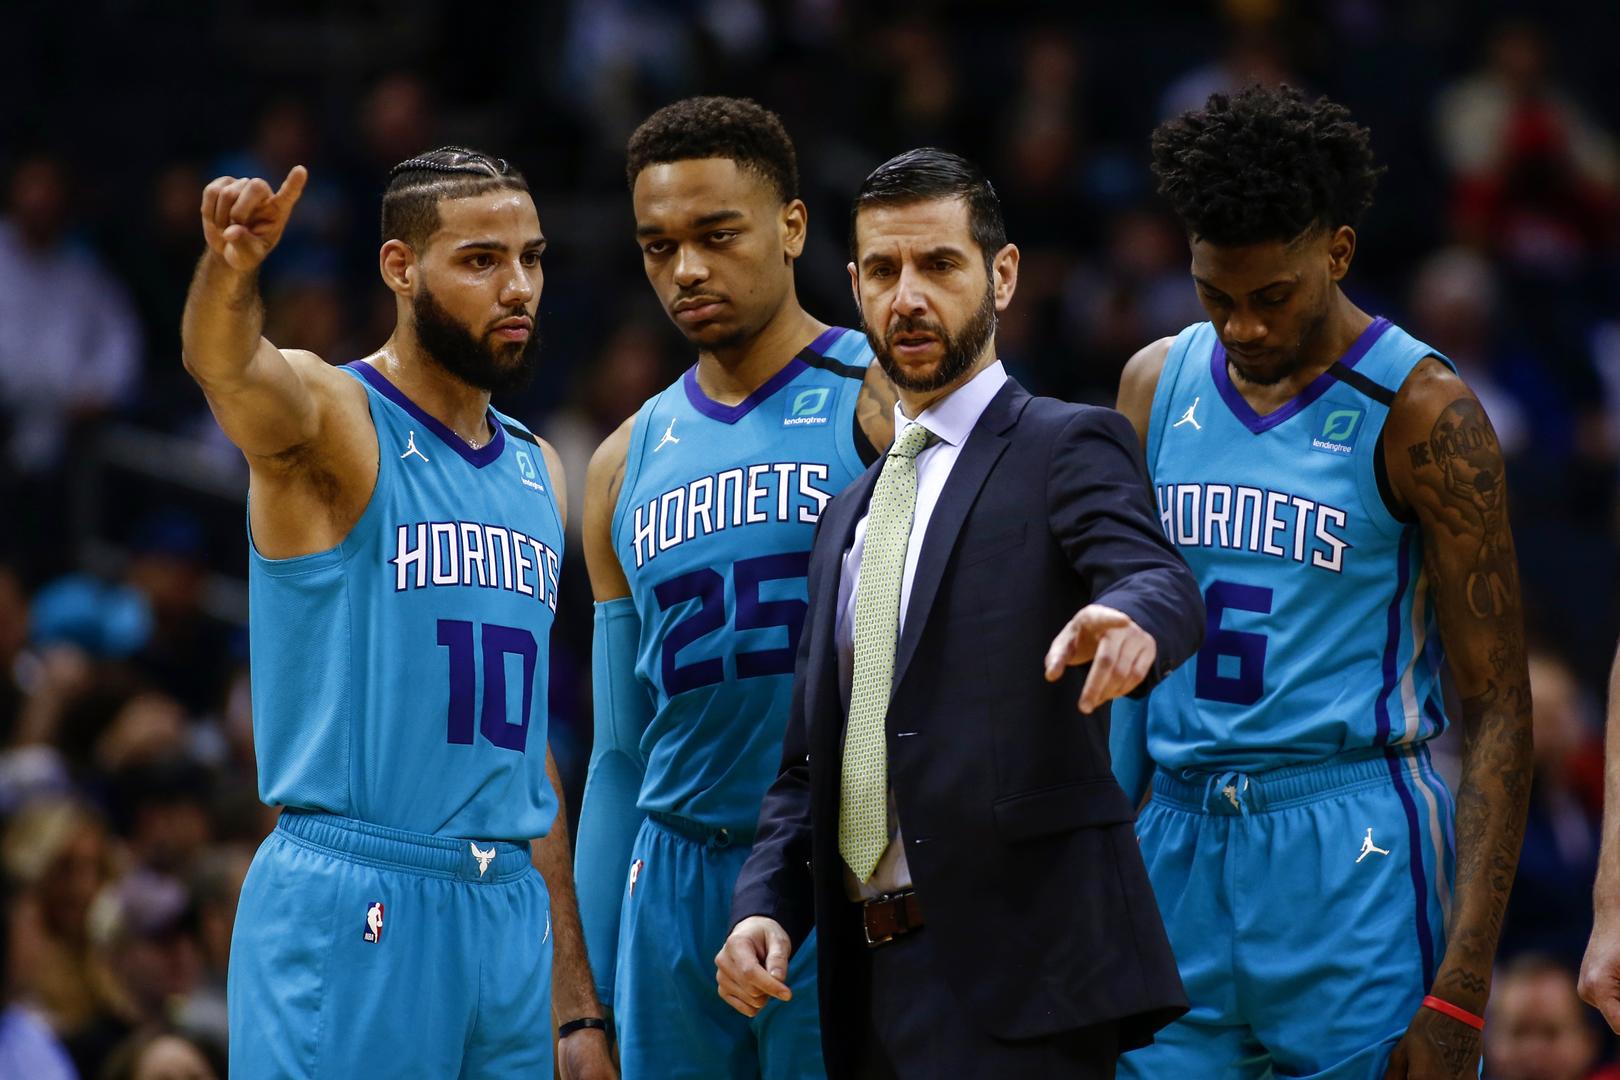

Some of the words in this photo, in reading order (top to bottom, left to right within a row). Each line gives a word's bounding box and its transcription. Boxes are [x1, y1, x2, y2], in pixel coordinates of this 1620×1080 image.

[783, 416, 827, 425] lendingtree
[1312, 438, 1352, 453] lendingtree
[631, 463, 833, 570] HORNETS
[1157, 483, 1354, 574] HORNETS
[388, 520, 558, 614] HORNETS
[653, 552, 811, 699] 25
[1195, 580, 1274, 706] 6
[436, 618, 538, 754] 10
